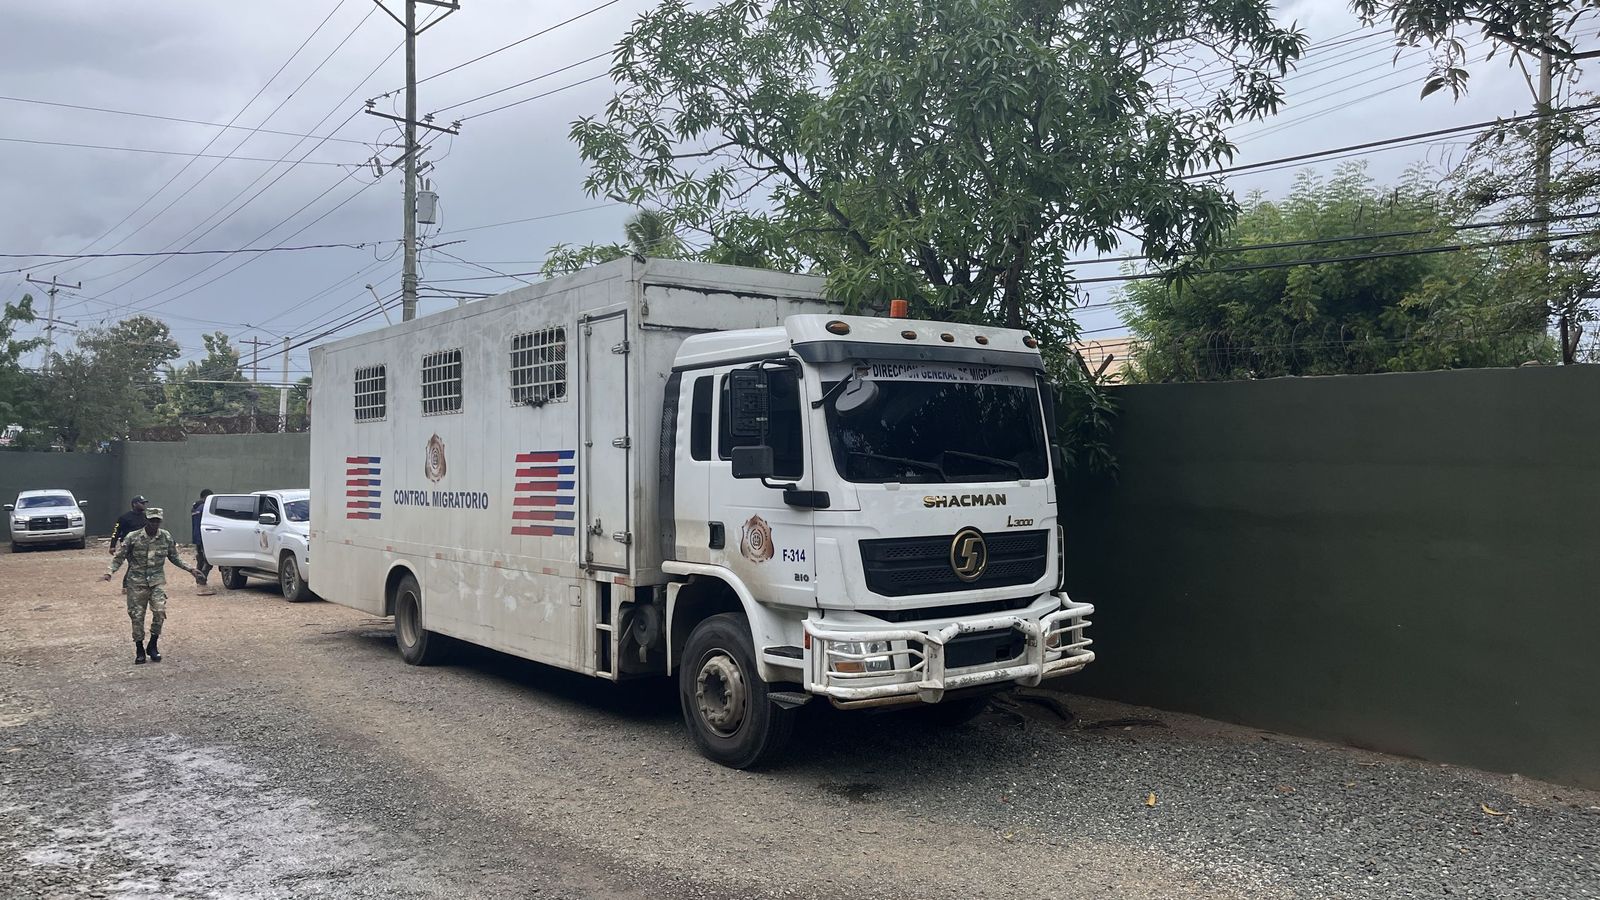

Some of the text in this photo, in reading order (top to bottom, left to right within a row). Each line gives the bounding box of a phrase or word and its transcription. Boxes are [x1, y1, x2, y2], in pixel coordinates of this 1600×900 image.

[393, 489, 489, 510] CONTROL MIGRATORIO
[923, 493, 1007, 508] SHACMAN
[1006, 515, 1034, 528] L3000
[782, 549, 806, 562] F-314
